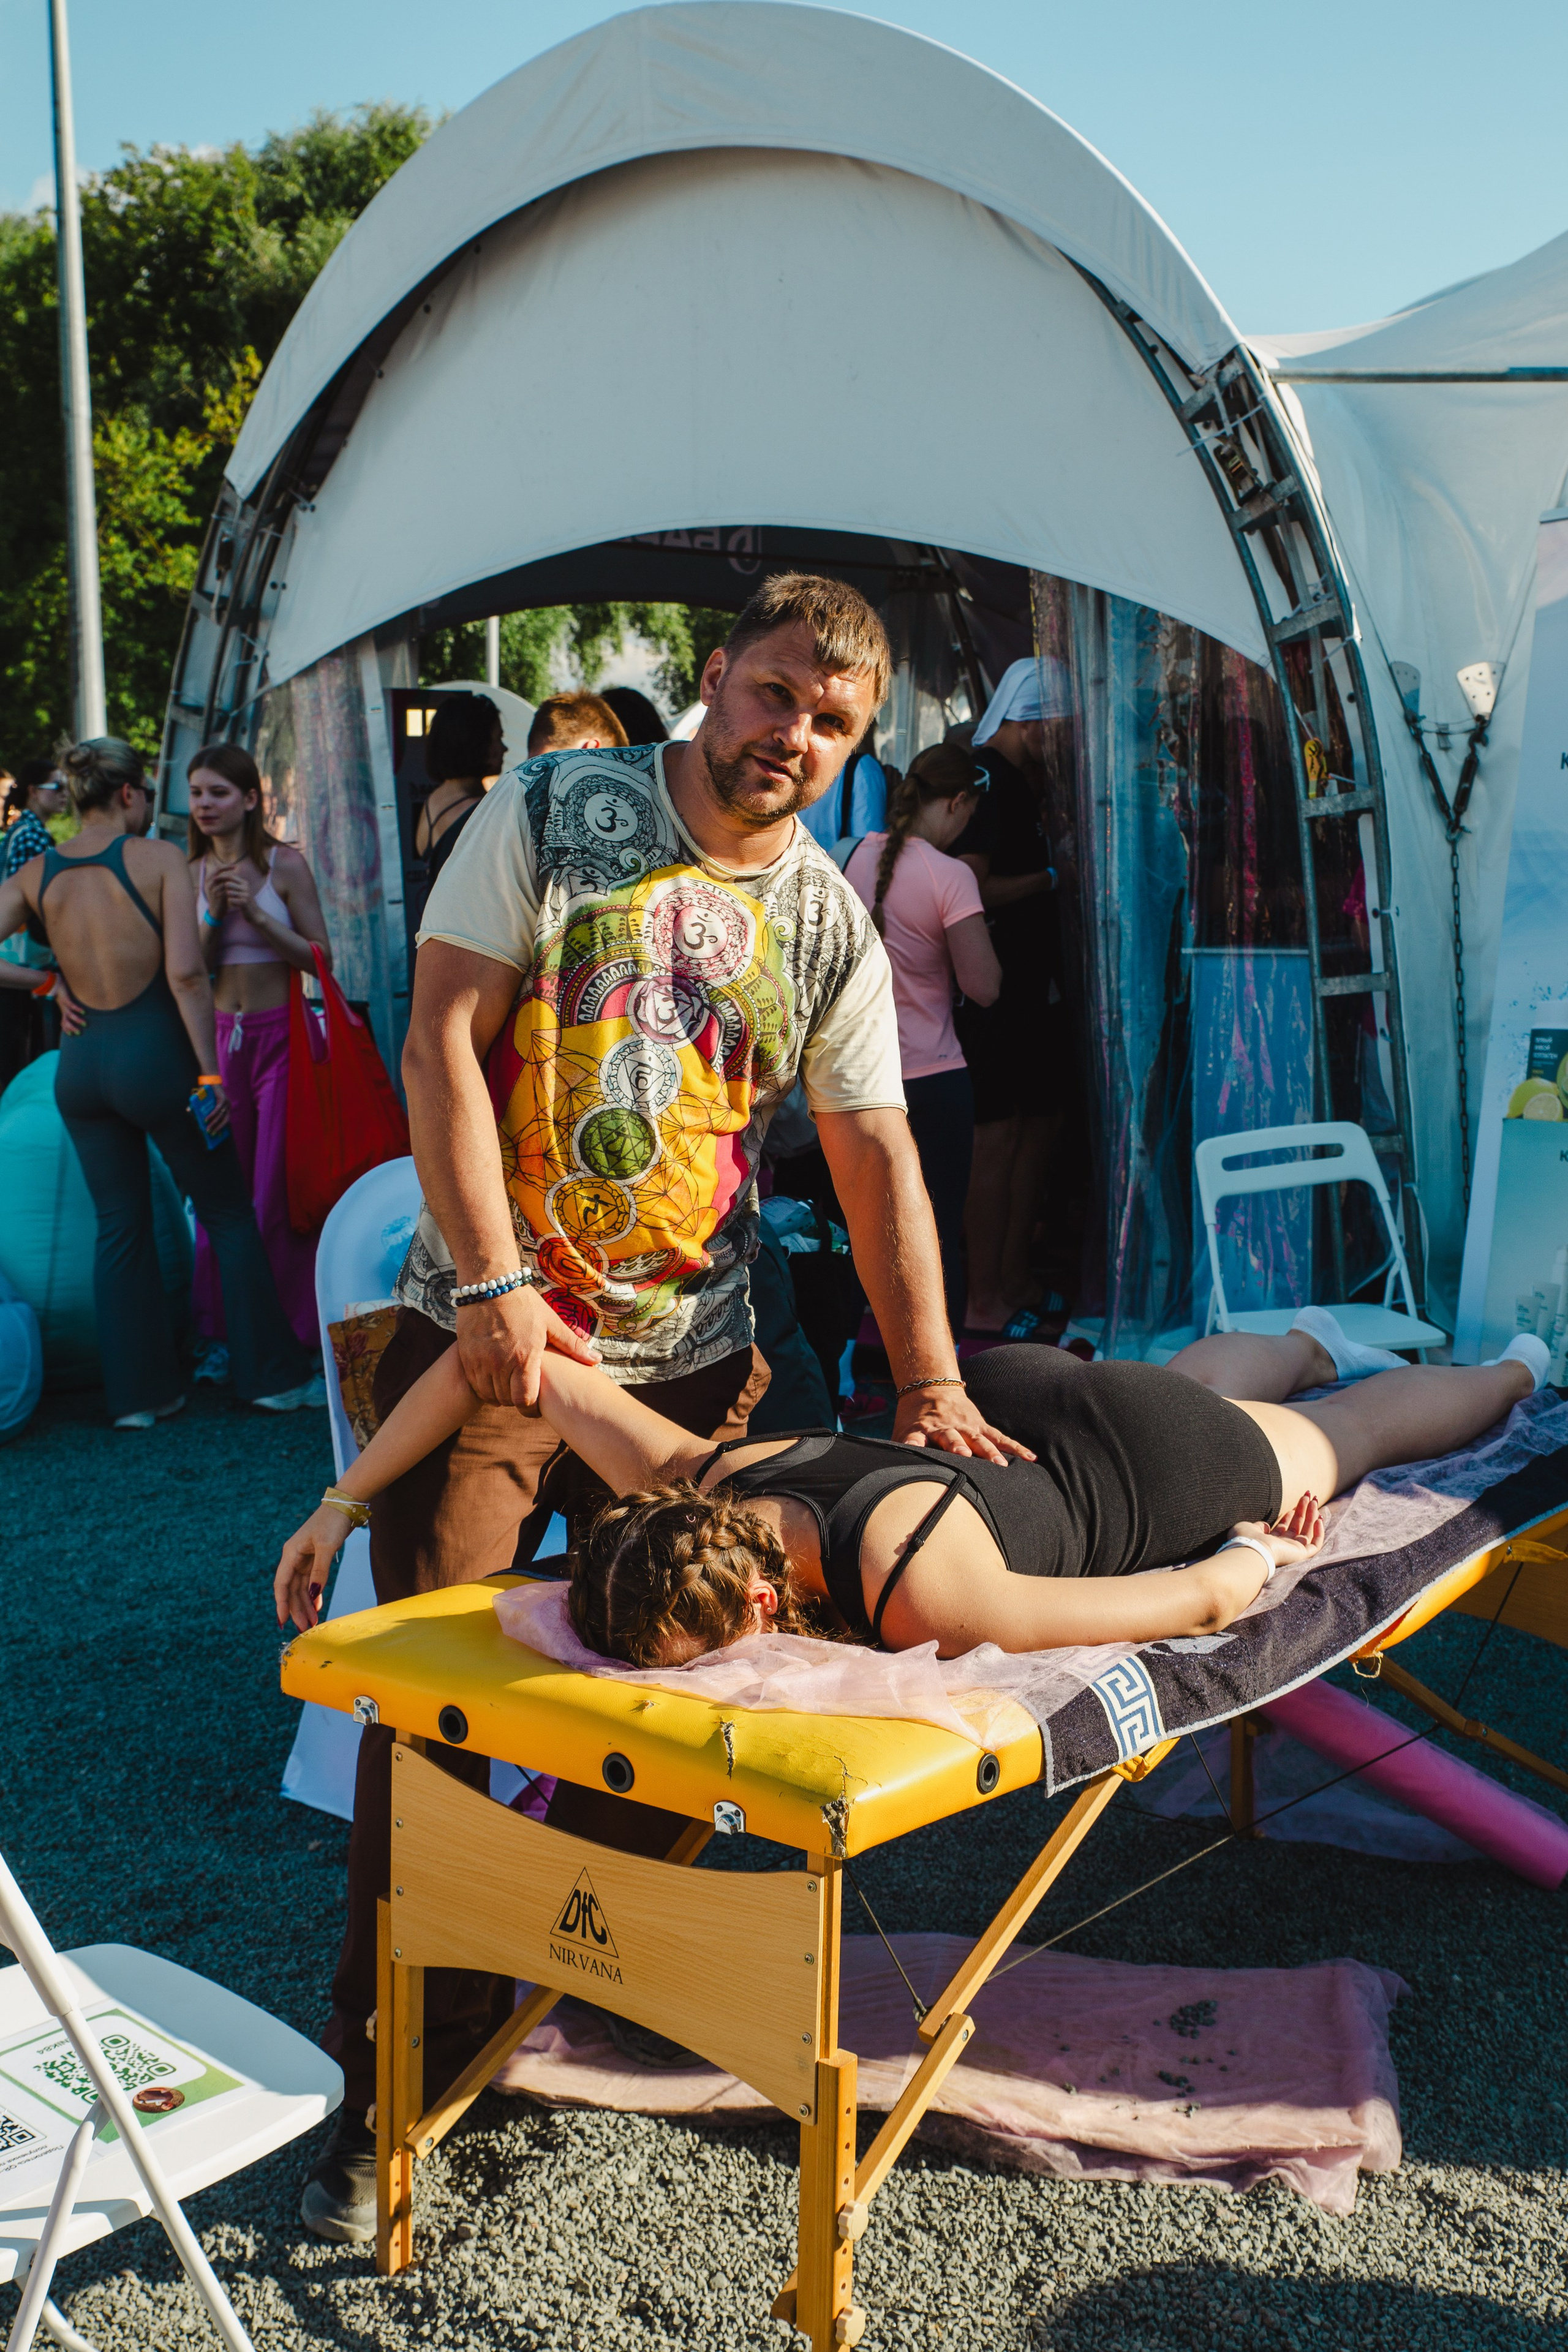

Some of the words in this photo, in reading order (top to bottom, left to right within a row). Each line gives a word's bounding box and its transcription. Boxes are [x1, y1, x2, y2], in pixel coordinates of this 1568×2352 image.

[549, 1943, 624, 1985] NIRVANA
[7, 2145, 47, 2163] получения
[17, 2145, 64, 2165] Поделитесь
